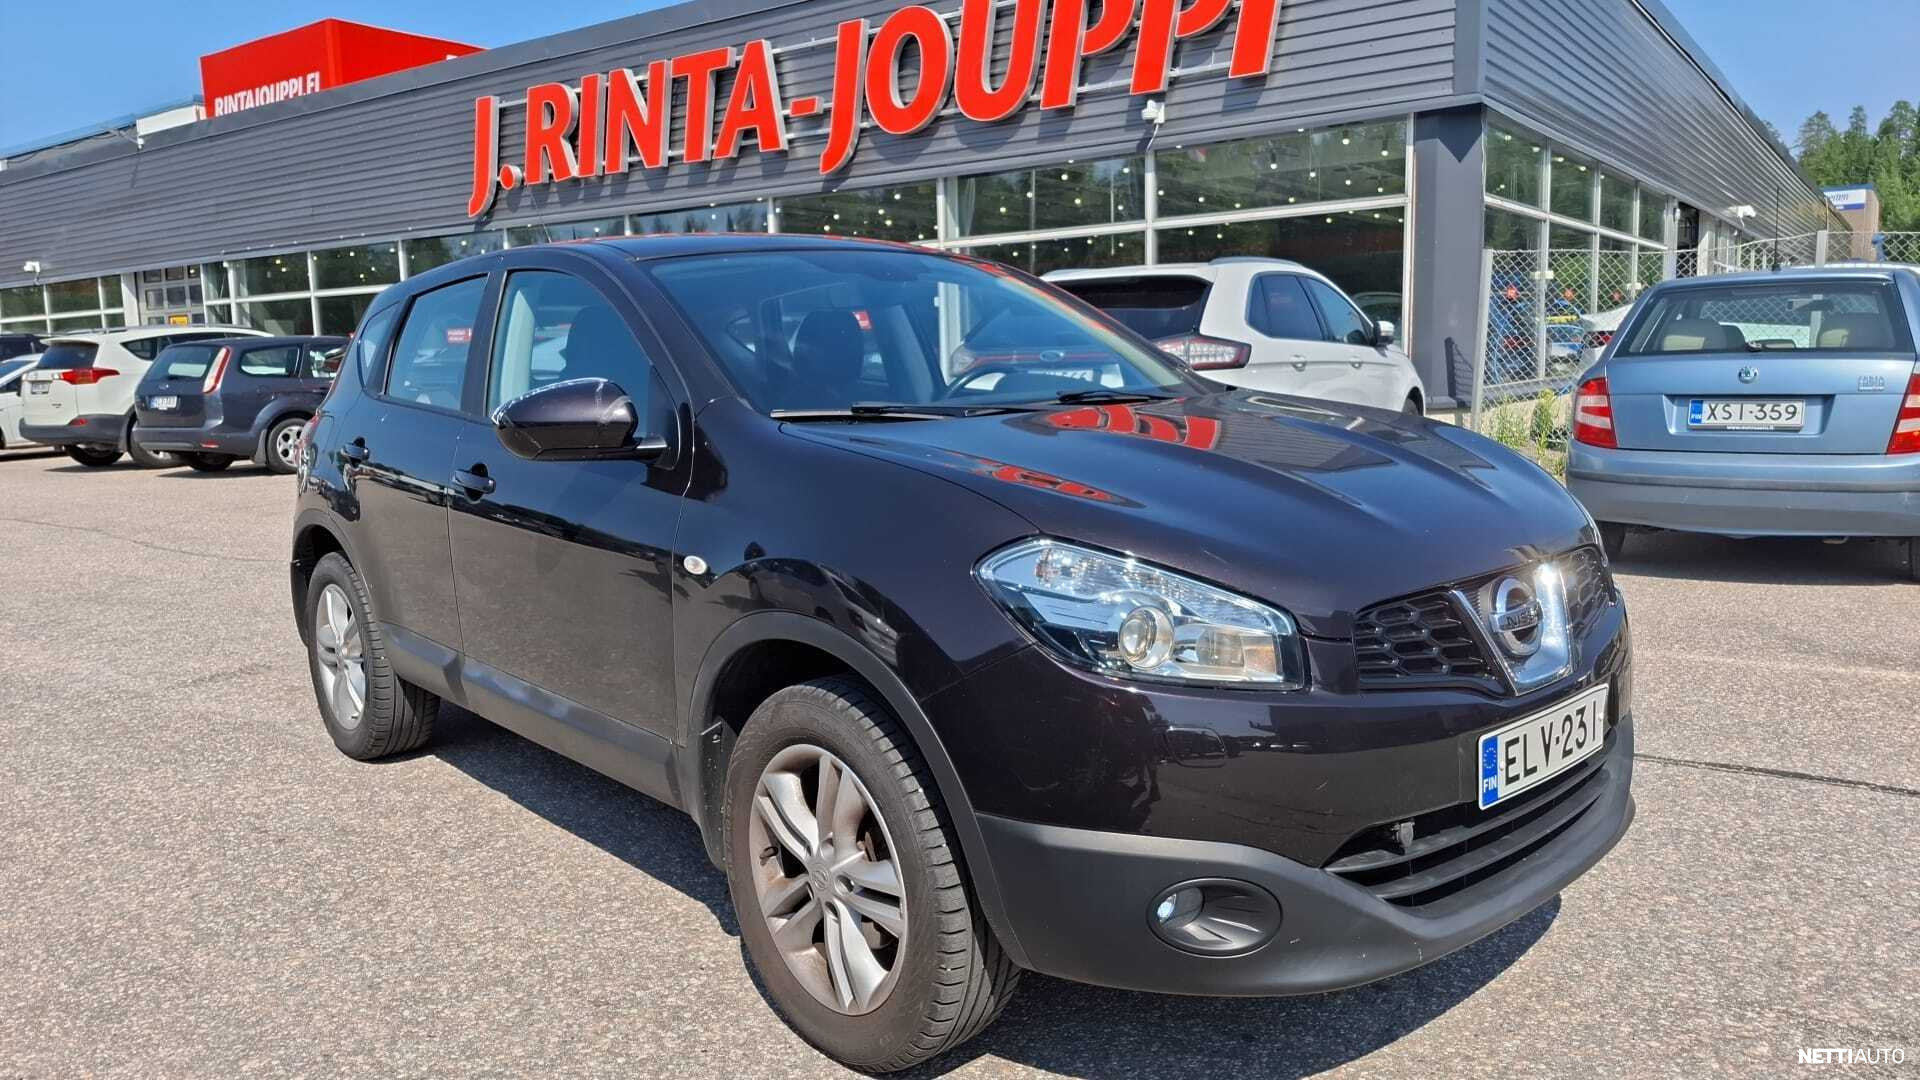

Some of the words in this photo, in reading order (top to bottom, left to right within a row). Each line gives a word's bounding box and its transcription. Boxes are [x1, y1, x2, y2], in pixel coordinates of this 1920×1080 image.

[1707, 403, 1798, 421] XSI-359
[1483, 775, 1498, 793] FIN
[1505, 701, 1597, 787] ELV-231
